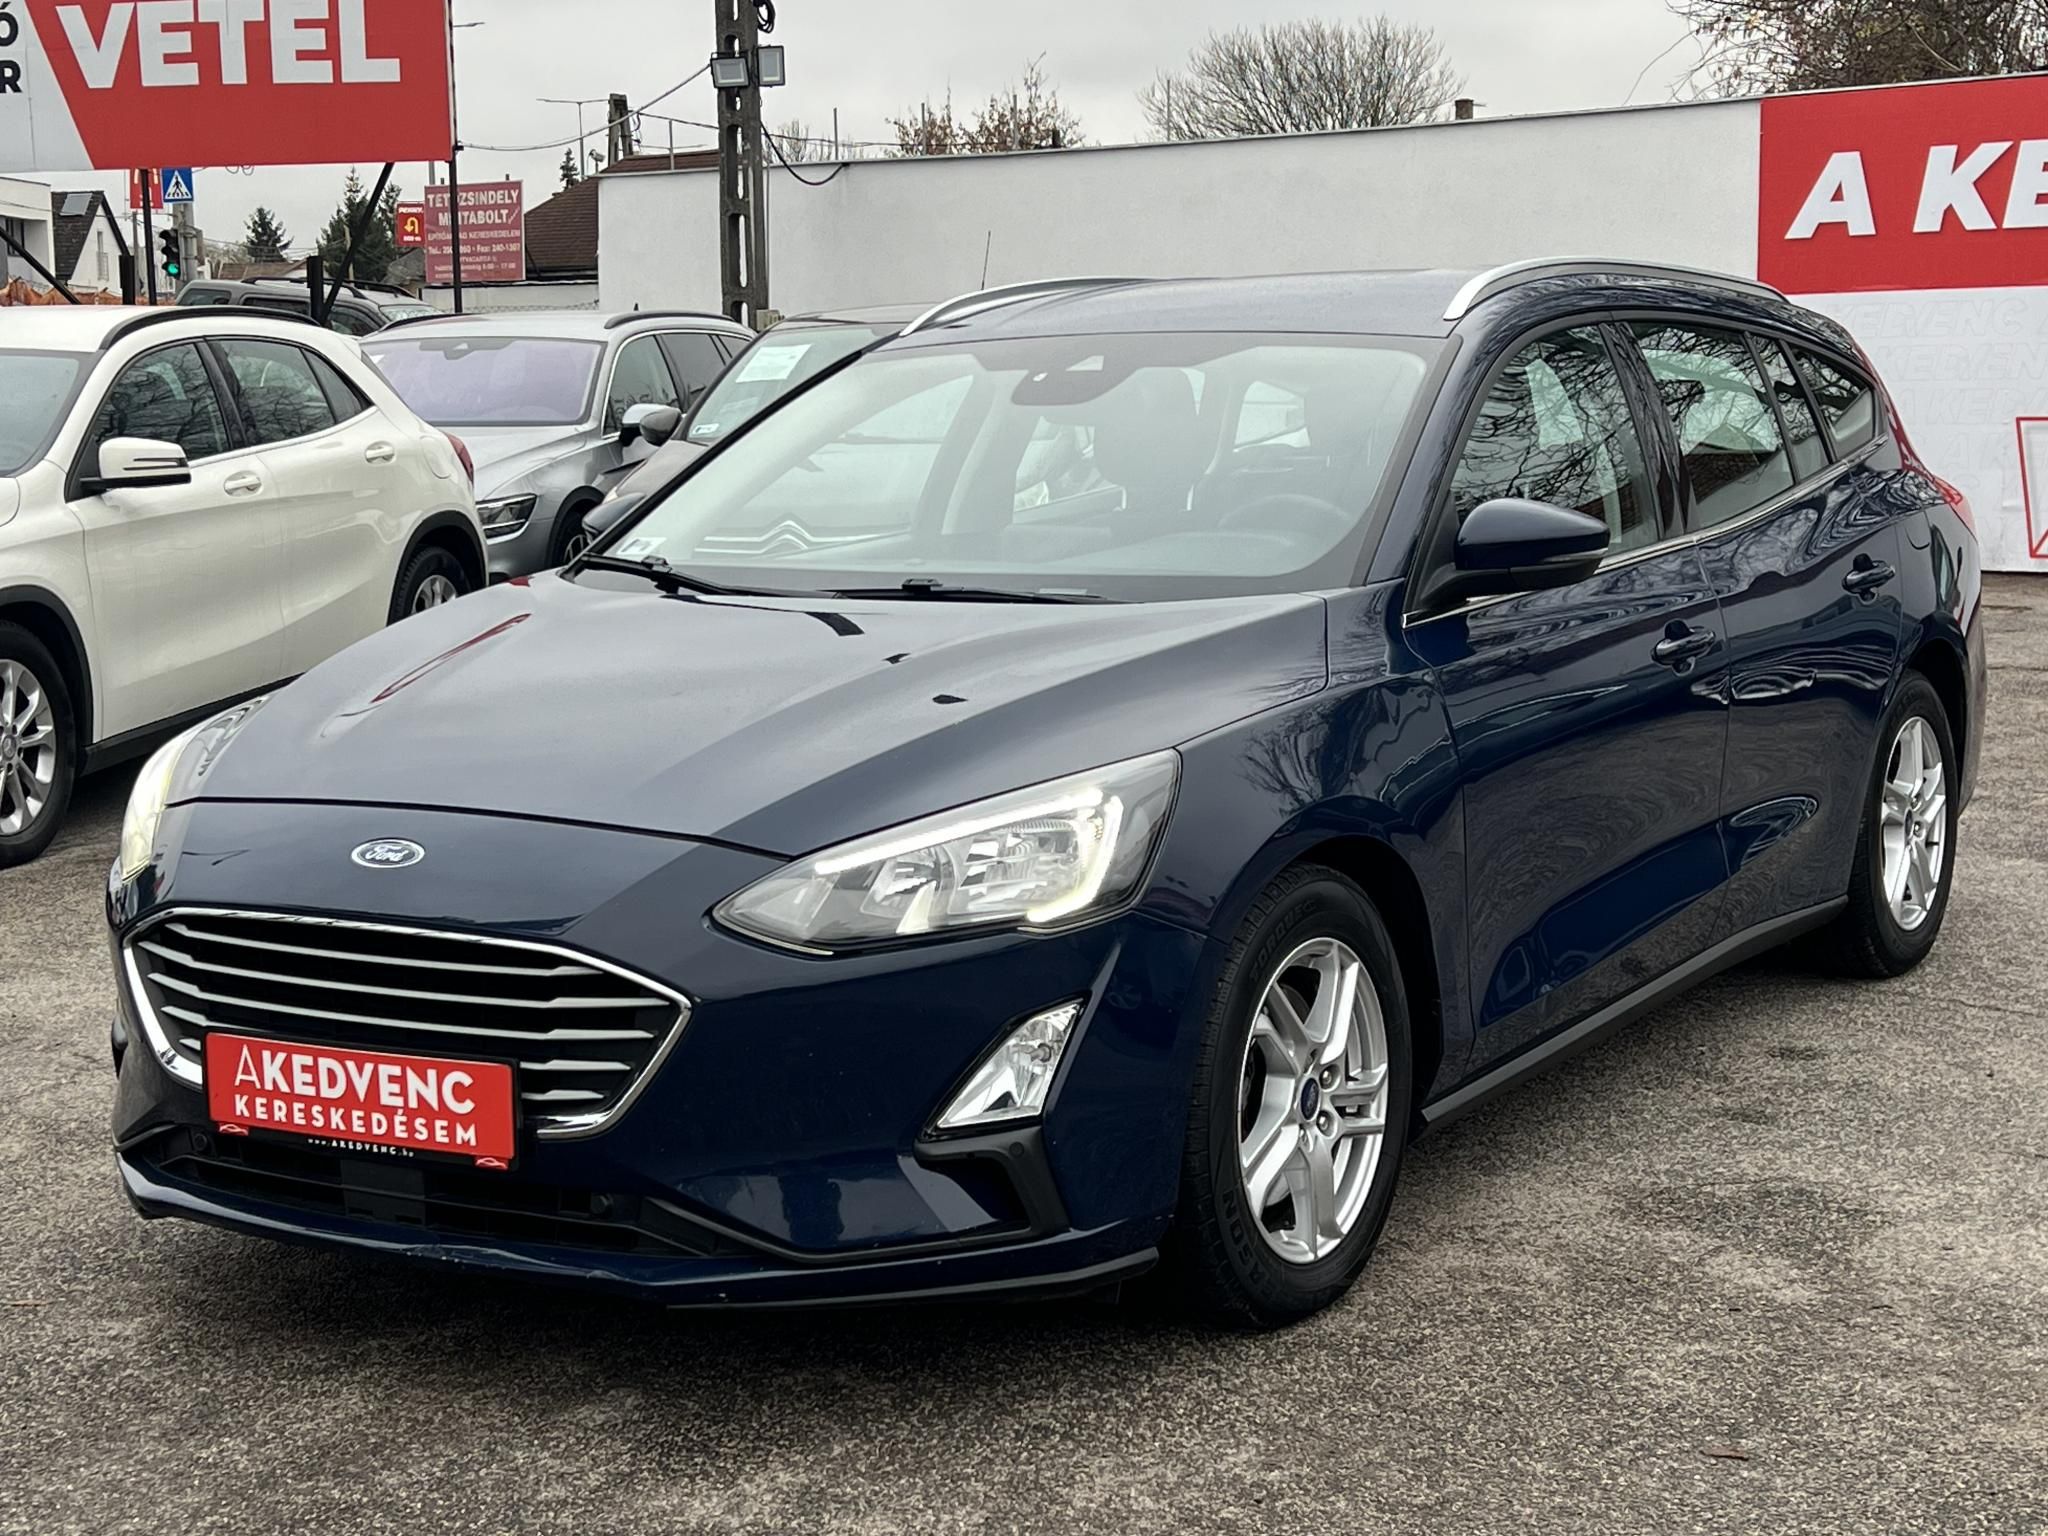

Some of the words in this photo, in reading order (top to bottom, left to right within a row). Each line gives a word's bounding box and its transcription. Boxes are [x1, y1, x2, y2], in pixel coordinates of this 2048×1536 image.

[427, 189, 519, 208] TETZSINDELY
[1784, 151, 1877, 240] A
[364, 843, 410, 862] Ford
[233, 1093, 477, 1147] KERESKEDÉSEM
